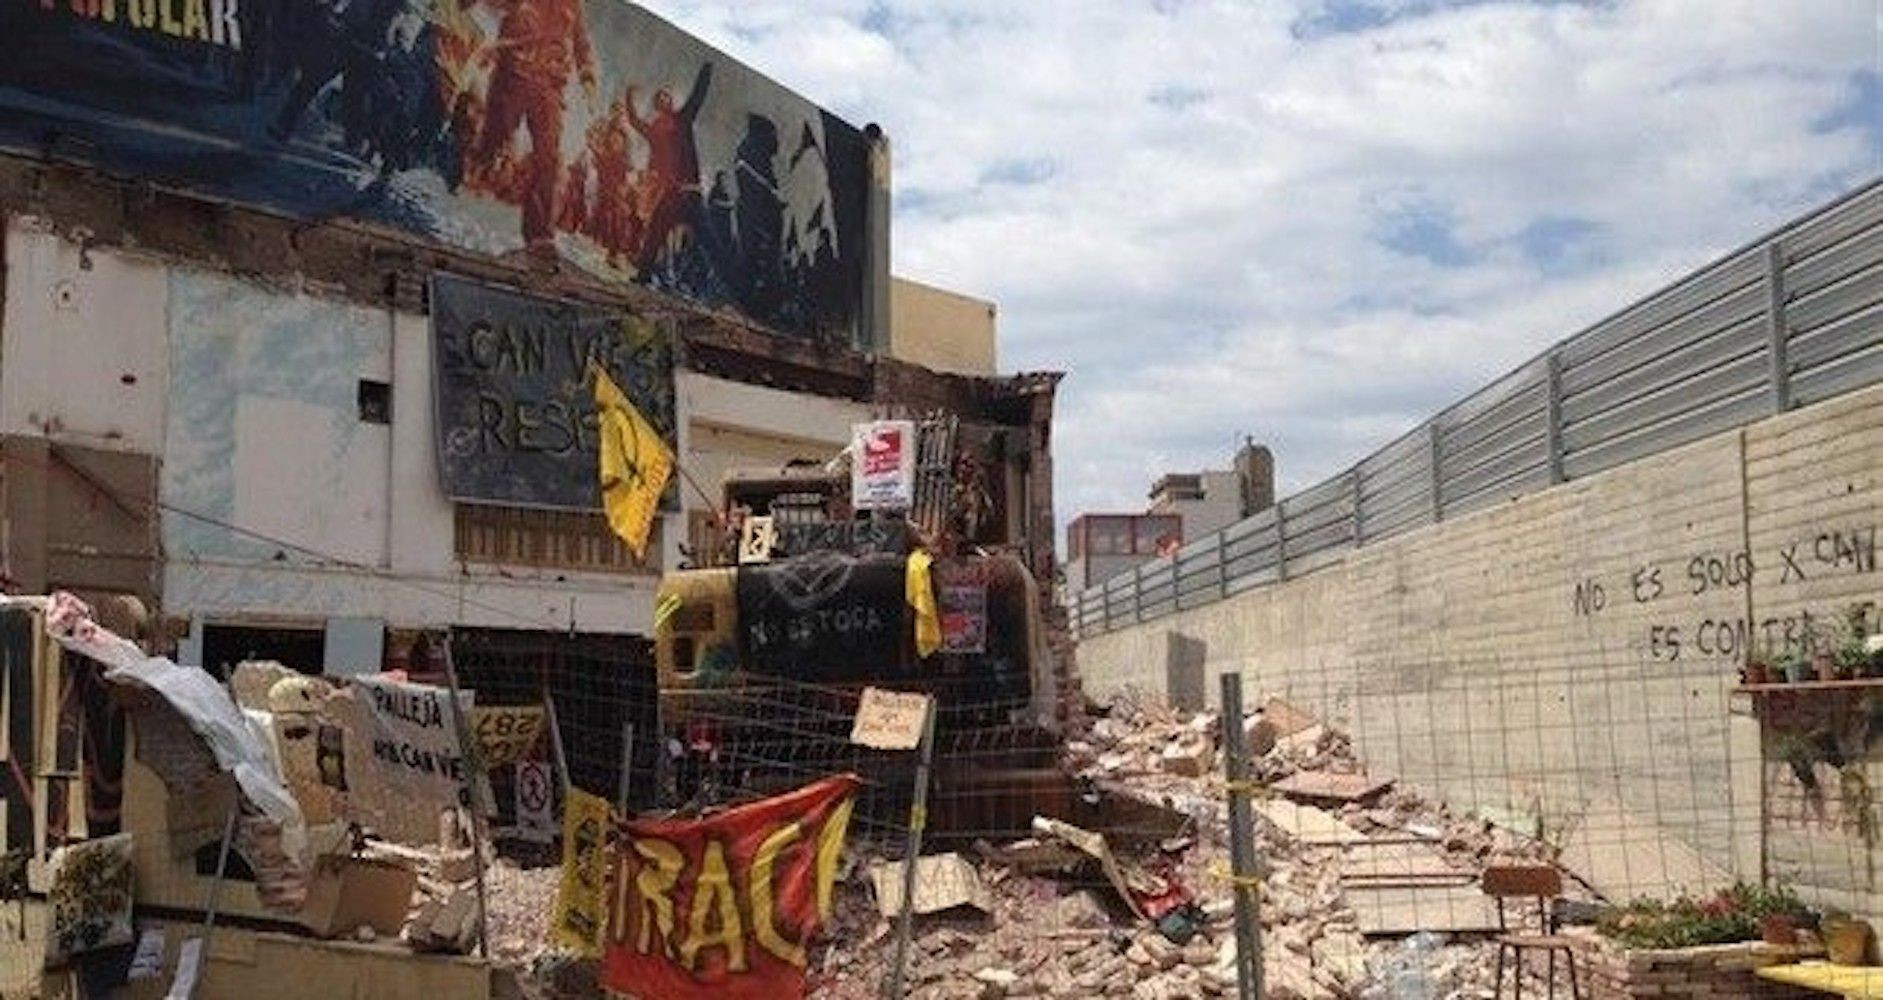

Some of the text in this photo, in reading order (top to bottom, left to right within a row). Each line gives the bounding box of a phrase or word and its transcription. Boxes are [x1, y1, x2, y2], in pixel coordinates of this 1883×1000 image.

[467, 318, 549, 373] CAN
[1575, 526, 1876, 616] NO ES SOLO X CAN
[1651, 625, 1681, 662] ES
